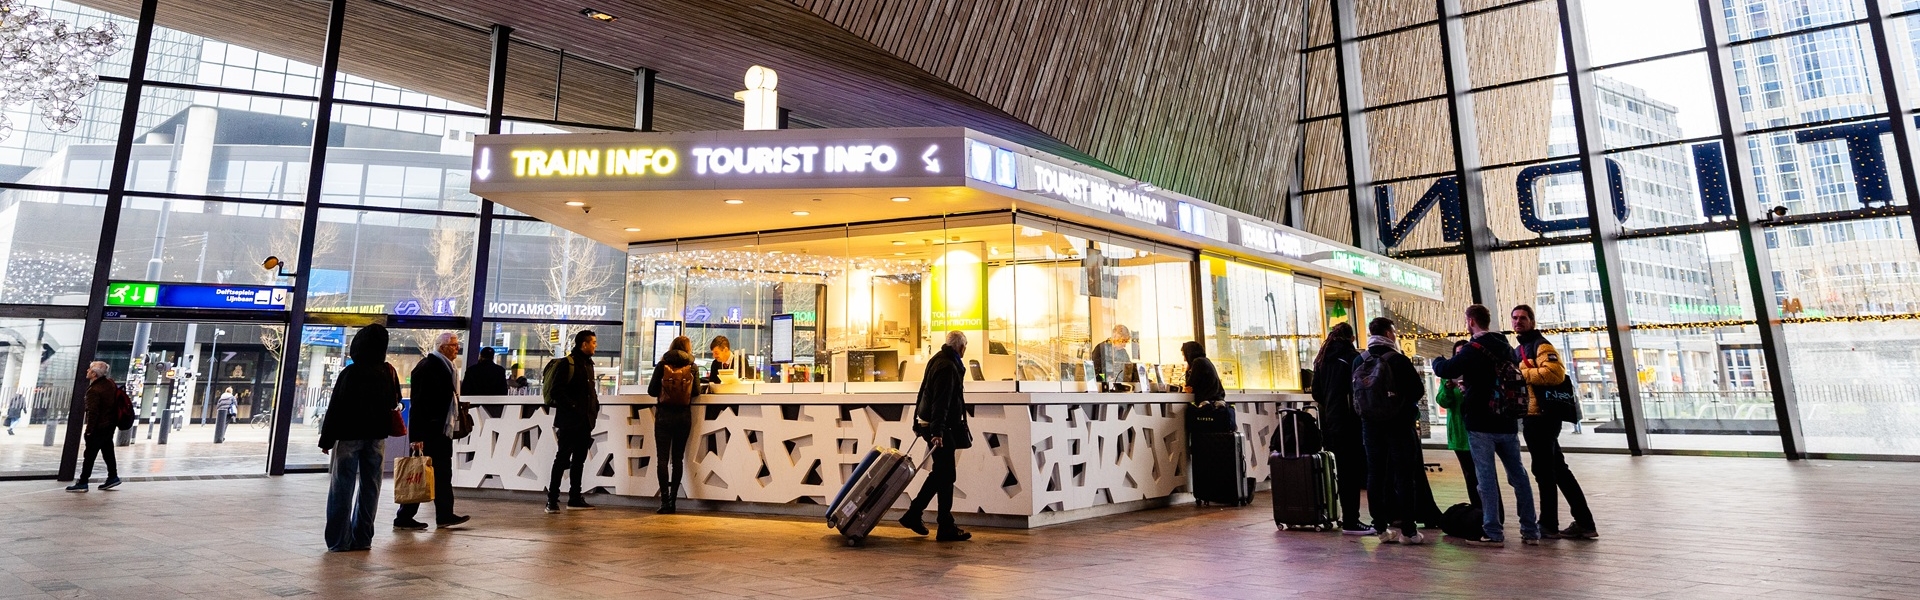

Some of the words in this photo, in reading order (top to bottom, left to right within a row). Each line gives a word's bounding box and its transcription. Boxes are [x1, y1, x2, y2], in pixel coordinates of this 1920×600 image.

[511, 148, 600, 176] TRAIN
[606, 147, 678, 176] INFO
[693, 144, 819, 175] TOURIST
[825, 144, 897, 173] INFO
[1034, 165, 1089, 203] TOURIST
[1091, 181, 1167, 222] INFORMATION
[216, 289, 254, 297] Delftseplein
